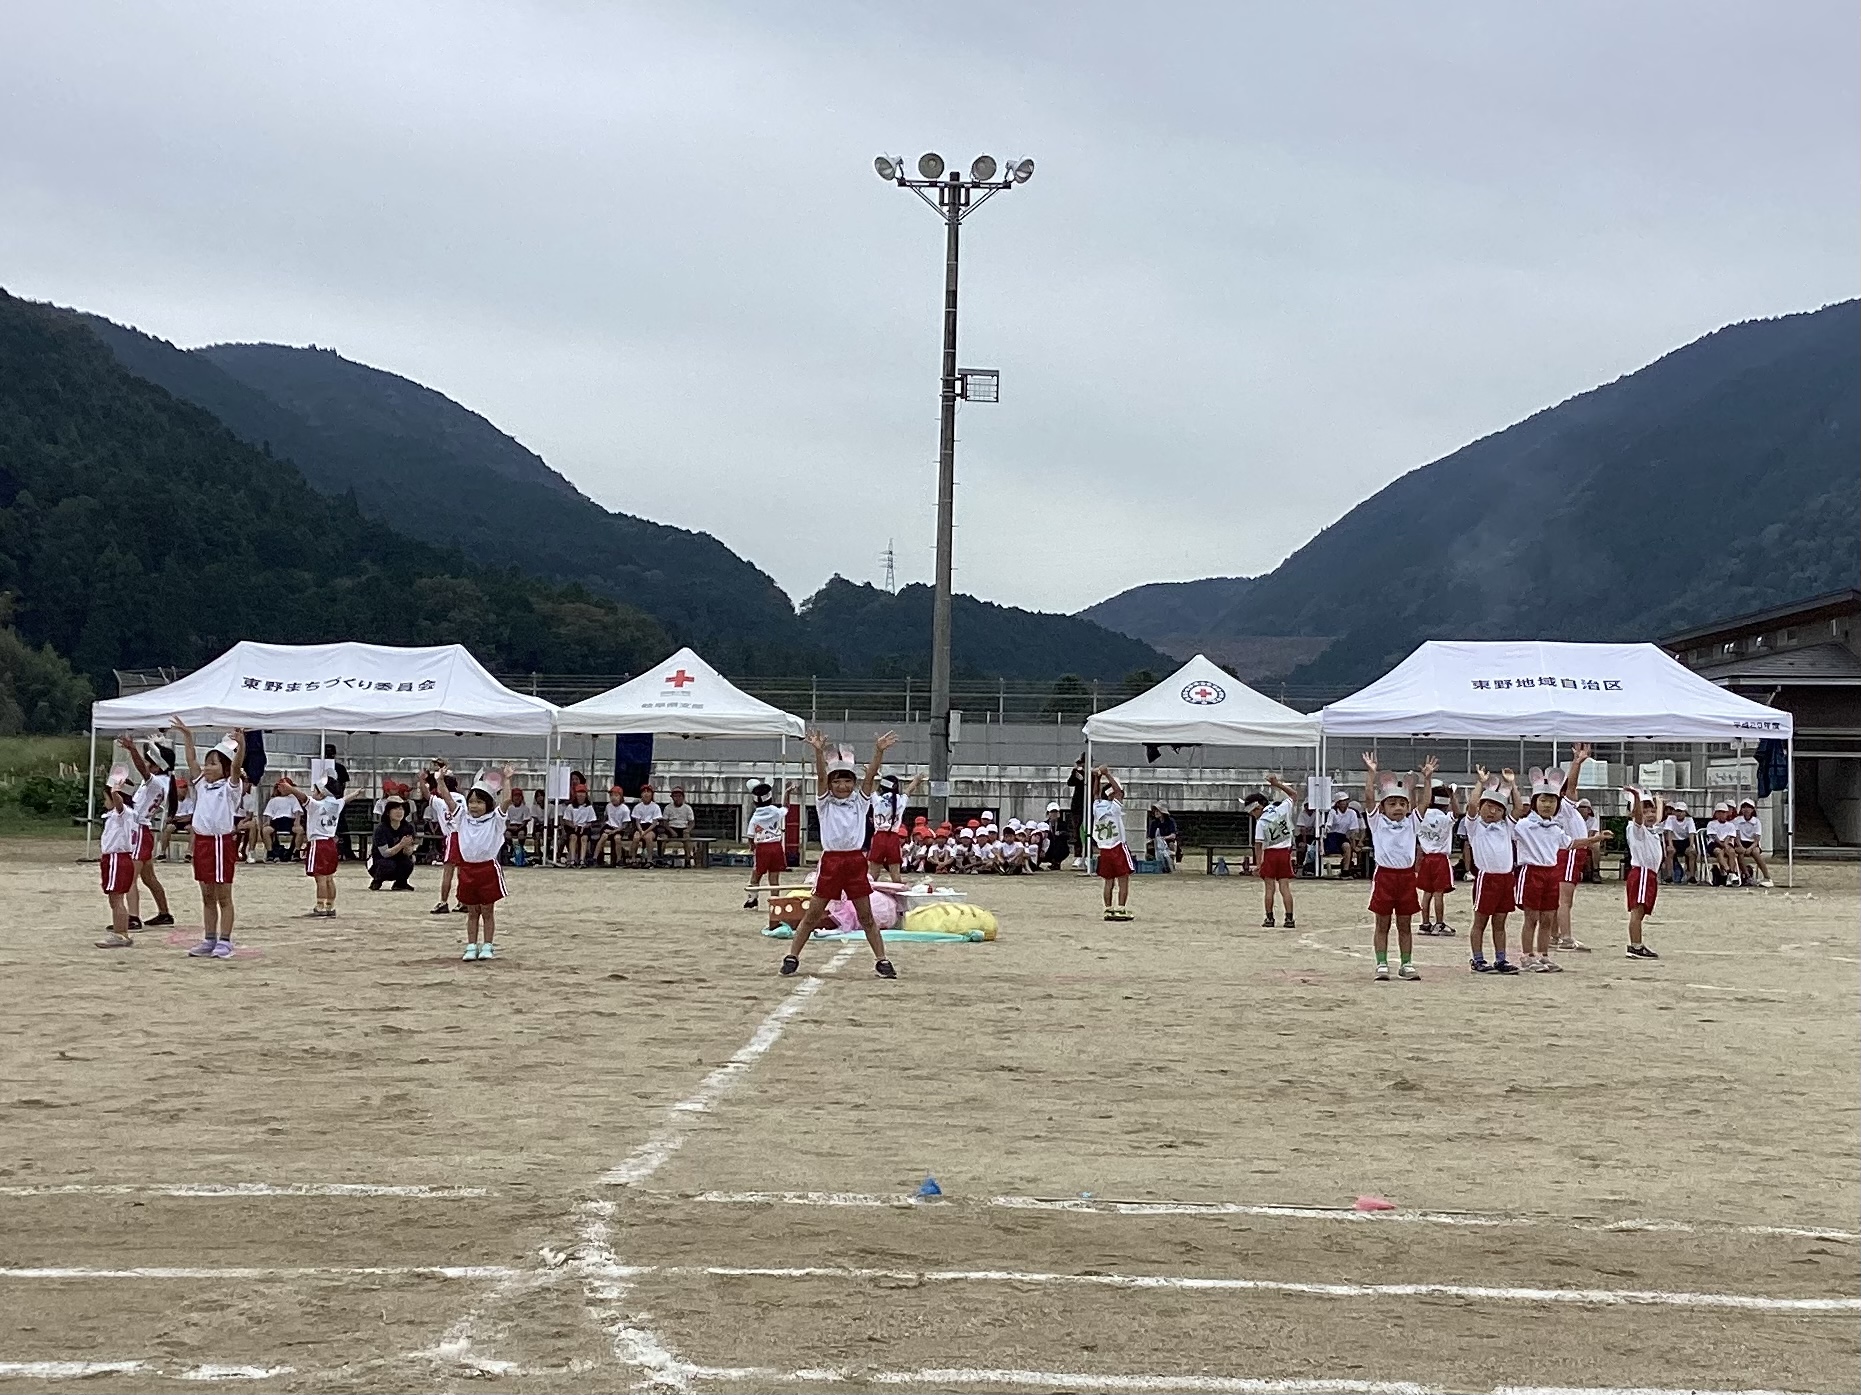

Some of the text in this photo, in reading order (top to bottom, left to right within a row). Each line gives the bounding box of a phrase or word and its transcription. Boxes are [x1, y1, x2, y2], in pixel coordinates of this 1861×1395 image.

[241, 676, 436, 692] 東野まちづくり委員会
[1471, 676, 1623, 691] 東野地域自治区
